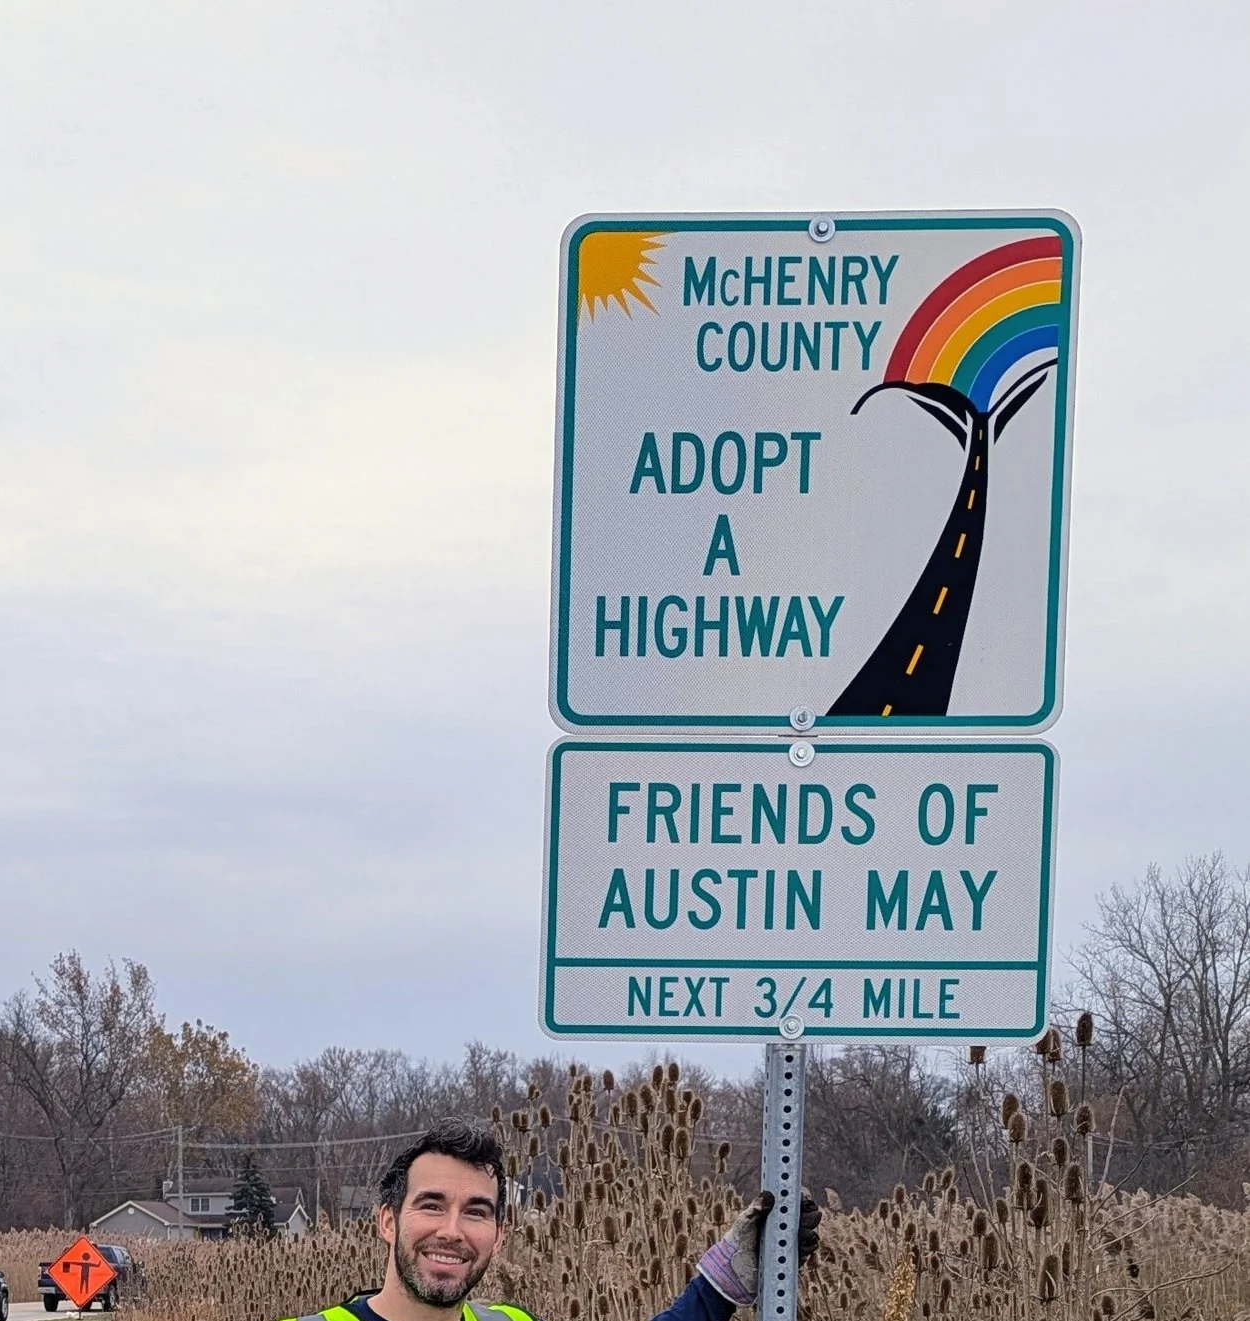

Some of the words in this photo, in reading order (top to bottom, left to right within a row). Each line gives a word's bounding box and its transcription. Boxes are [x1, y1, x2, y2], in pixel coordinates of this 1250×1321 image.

[683, 255, 898, 306] McHENRY
[697, 320, 881, 373] COUNTY
[630, 431, 821, 495] ADOPT
[703, 514, 740, 576] A
[595, 595, 844, 658] HIGHWAY
[608, 782, 876, 846] FRIENDS
[917, 783, 999, 847] OF
[599, 868, 822, 931] AUSTIN
[866, 869, 998, 931] MAY
[627, 975, 729, 1018] NEXT
[754, 976, 834, 1018] 3/4
[862, 978, 960, 1020] MILE
